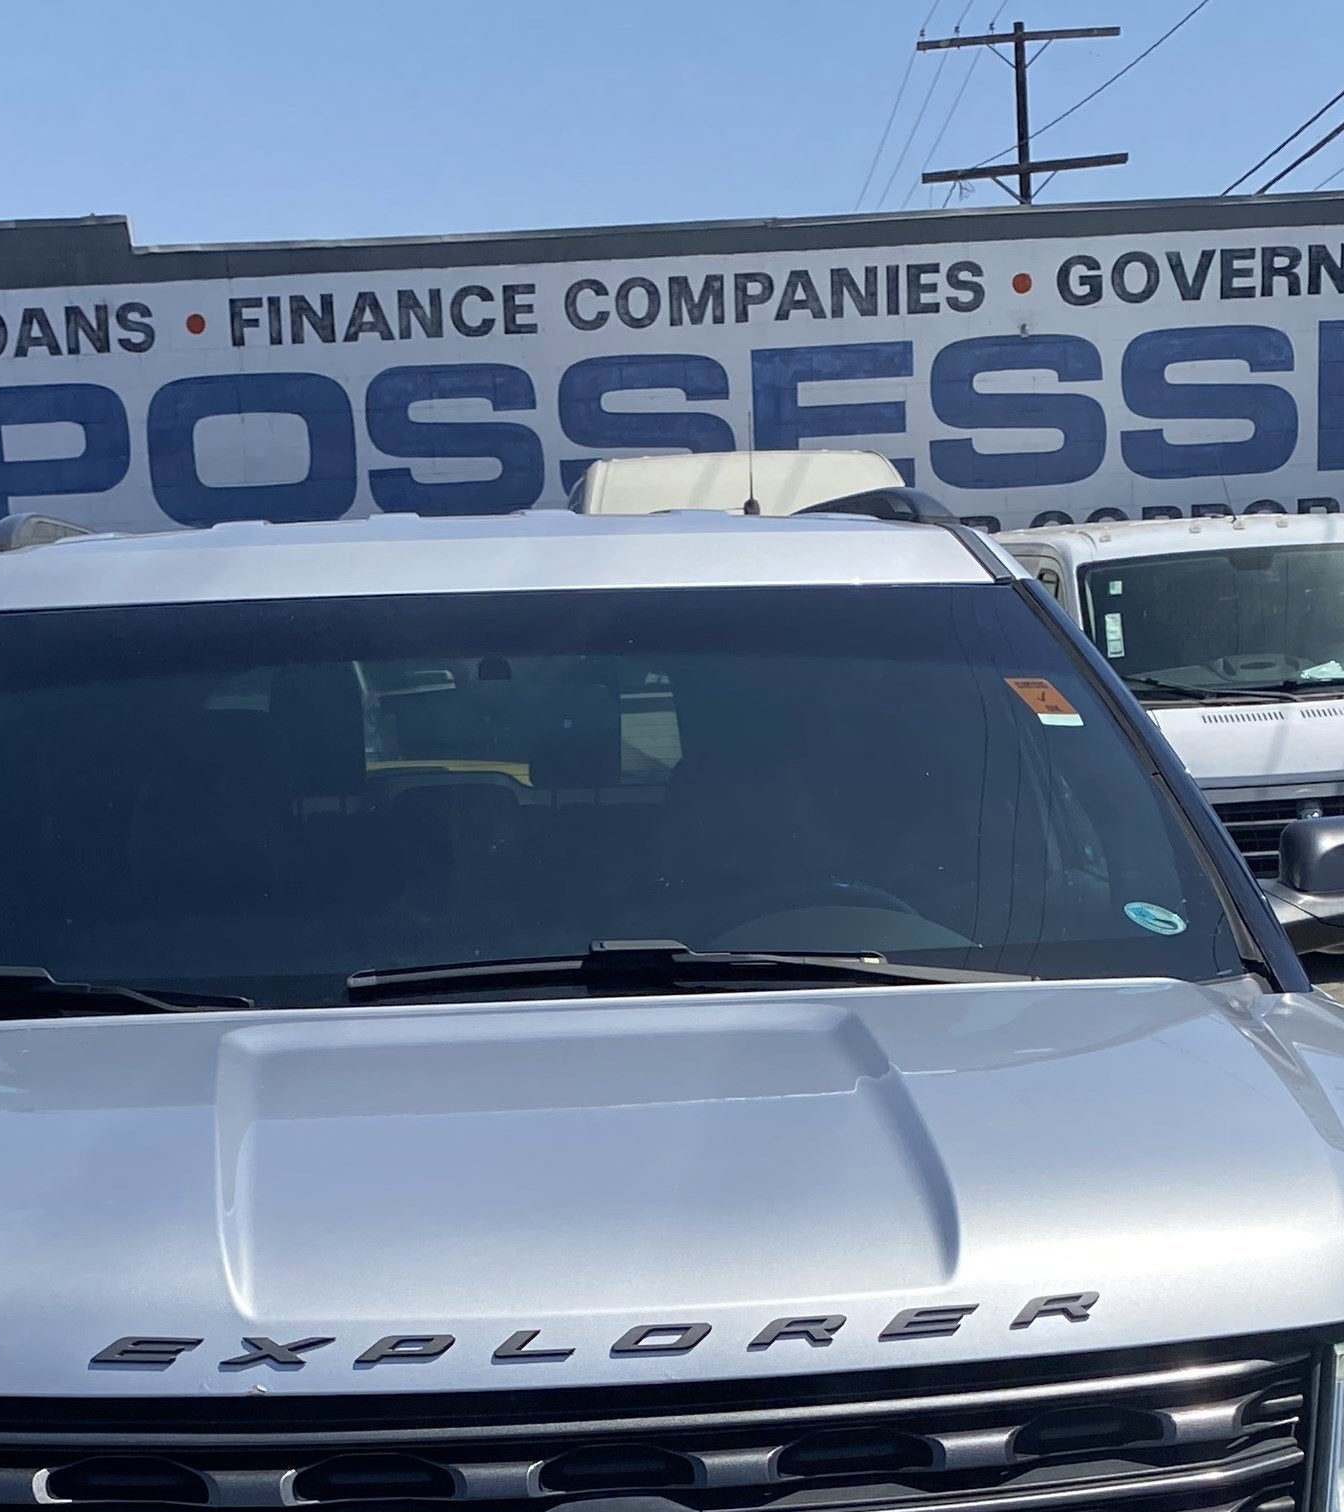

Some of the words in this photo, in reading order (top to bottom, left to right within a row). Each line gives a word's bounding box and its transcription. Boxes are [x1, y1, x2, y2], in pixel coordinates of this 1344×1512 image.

[230, 283, 537, 347] FINANCE
[565, 260, 986, 333] COMPANIES
[88, 1291, 1101, 1370] EXPLORER
